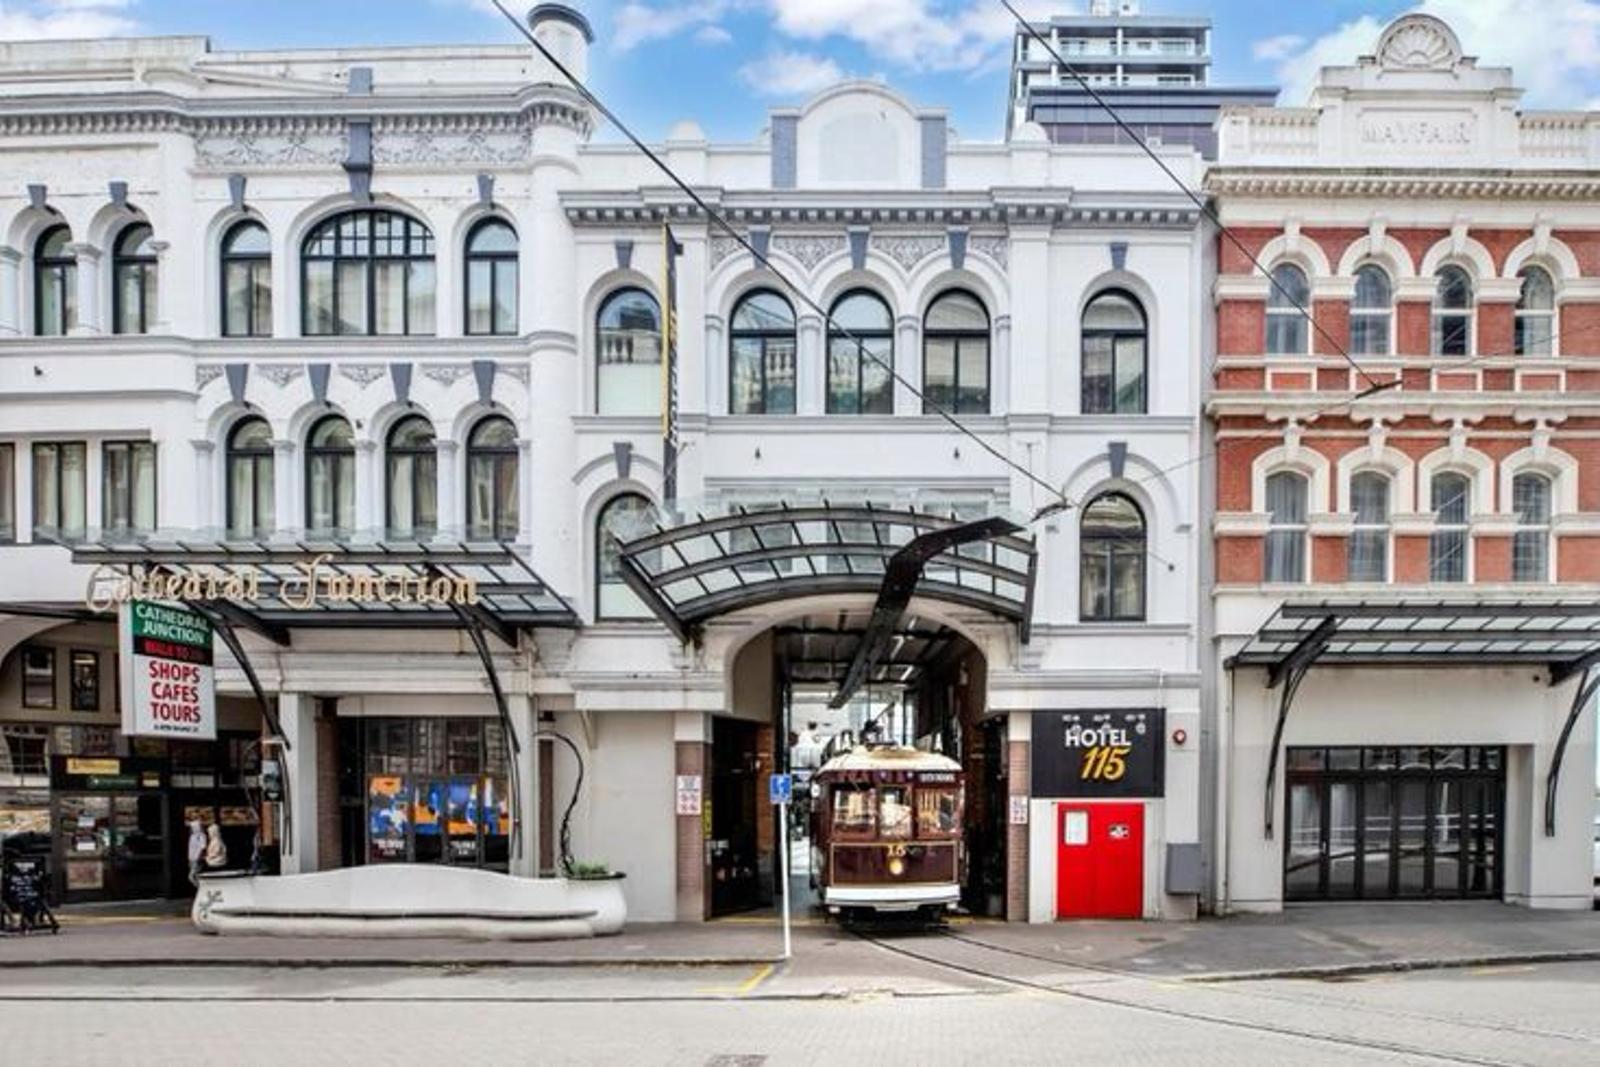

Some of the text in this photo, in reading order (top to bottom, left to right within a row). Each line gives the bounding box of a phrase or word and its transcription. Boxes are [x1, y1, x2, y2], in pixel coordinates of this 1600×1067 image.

[1360, 120, 1472, 143] MAYFAIR
[86, 553, 479, 613] Cathedral Junction
[136, 603, 209, 633] CATHEDRAL
[142, 621, 205, 644] JUNCTION
[148, 660, 201, 684] SHOPS
[151, 681, 199, 703] CAFES
[150, 702, 201, 724] TOURS
[1065, 729, 1132, 747] HOTEL
[1081, 746, 1131, 780] 115
